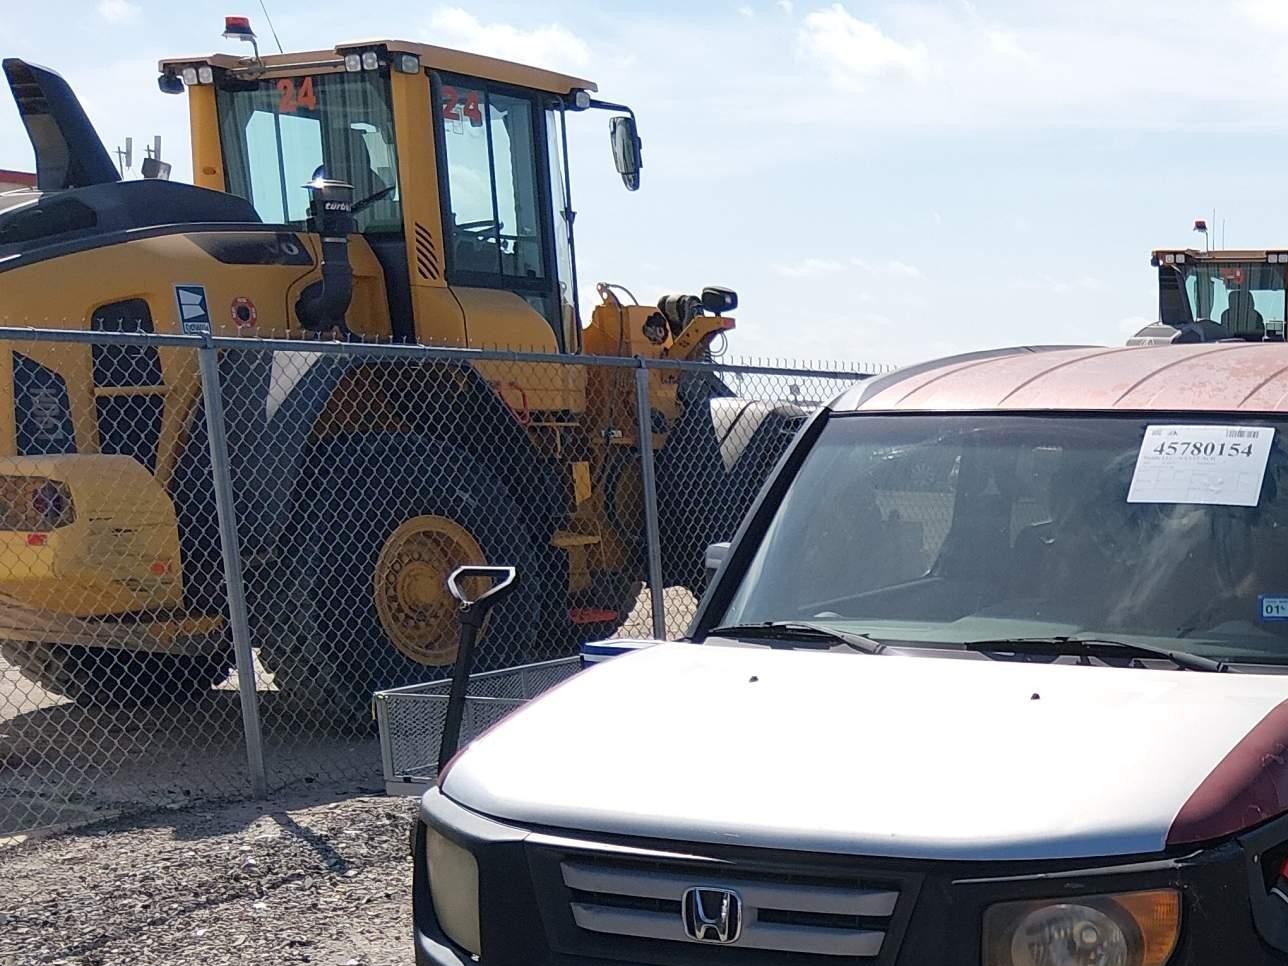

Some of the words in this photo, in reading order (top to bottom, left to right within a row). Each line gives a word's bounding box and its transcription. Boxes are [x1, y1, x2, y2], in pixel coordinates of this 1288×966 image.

[276, 77, 317, 113] 24
[442, 85, 483, 128] 24
[1153, 441, 1254, 458] 45780154
[1265, 604, 1280, 615] 01
